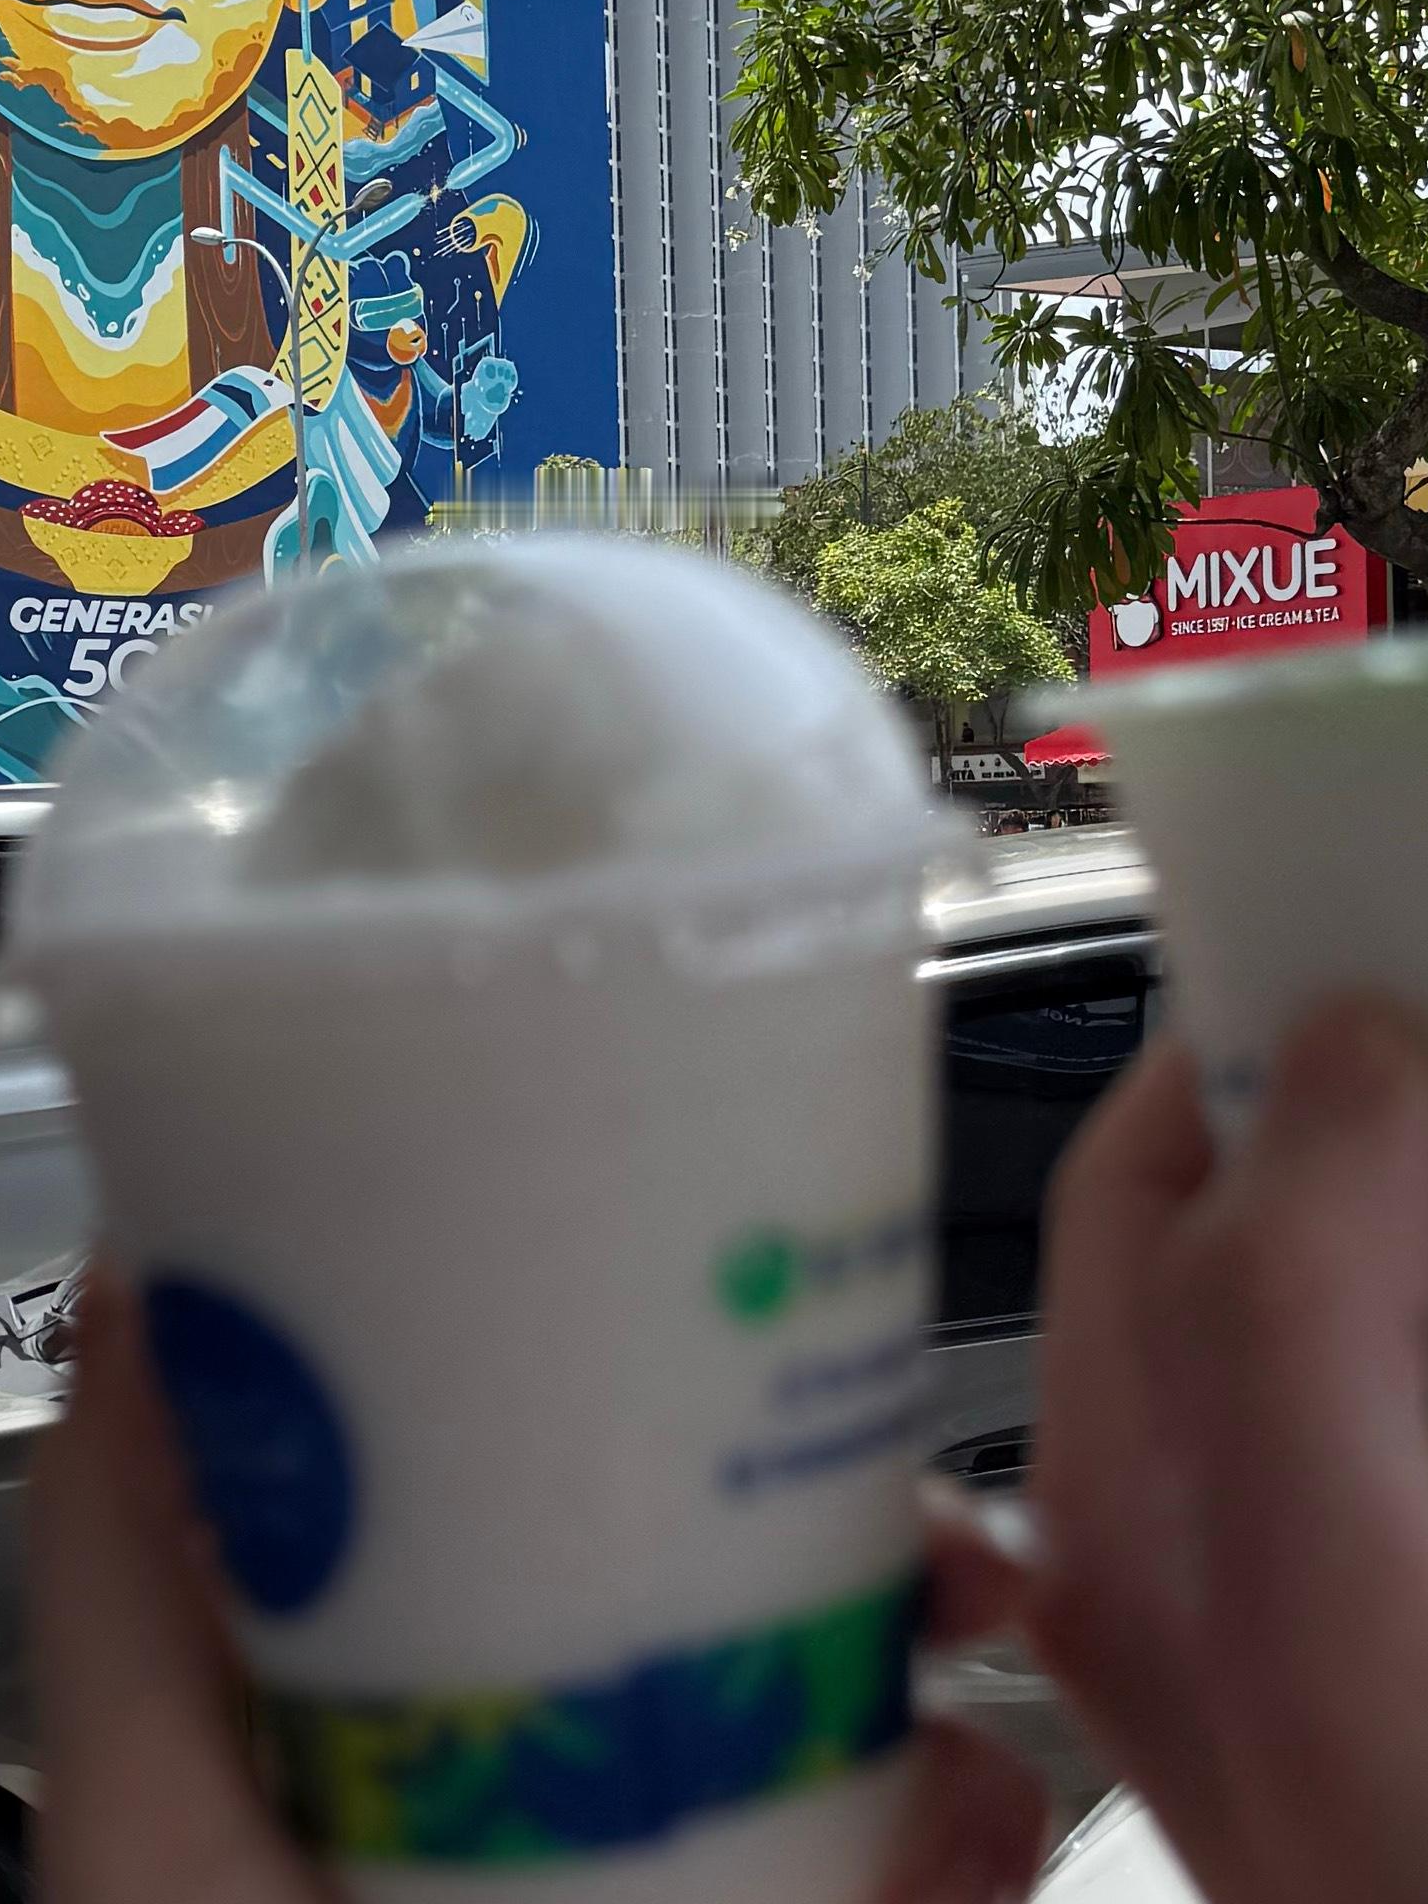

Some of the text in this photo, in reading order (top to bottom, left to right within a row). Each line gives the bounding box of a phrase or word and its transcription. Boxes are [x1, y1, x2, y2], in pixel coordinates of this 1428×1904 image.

[1167, 538, 1339, 612] MIXUE
[1171, 618, 1204, 636] SINCE
[1236, 614, 1256, 630] ICE
[1259, 610, 1302, 627] CREAM
[1315, 606, 1340, 623] TEA
